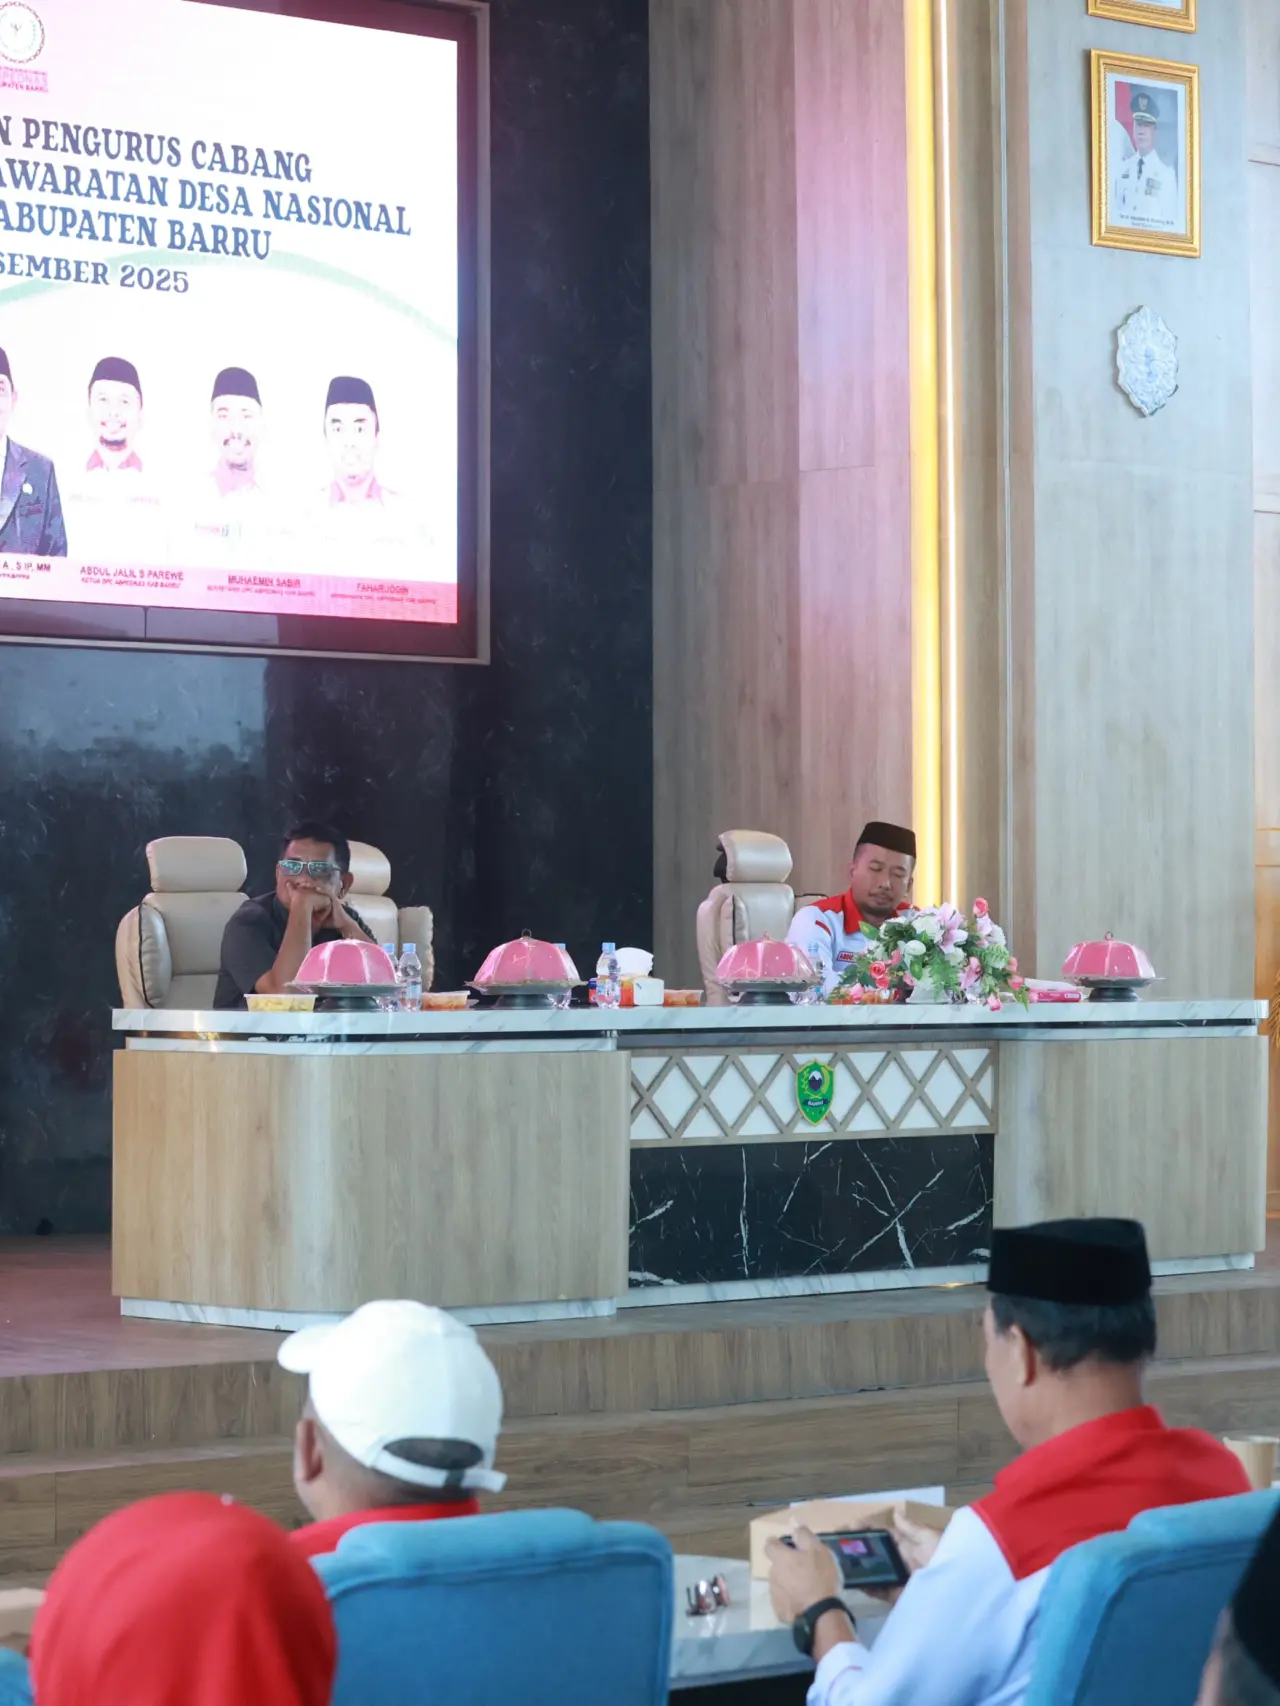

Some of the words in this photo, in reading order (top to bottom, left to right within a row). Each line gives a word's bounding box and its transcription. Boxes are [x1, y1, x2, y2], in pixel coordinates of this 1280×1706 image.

[22, 117, 182, 167] PENGURUS
[191, 139, 312, 183] CABANG
[178, 178, 253, 217] DESA
[263, 189, 412, 237] NASIONAL
[167, 219, 272, 261] BARRU
[120, 264, 190, 294] 2025
[80, 566, 111, 577] ABDUL
[113, 568, 137, 578] JALIL
[147, 570, 184, 581] PAREWE
